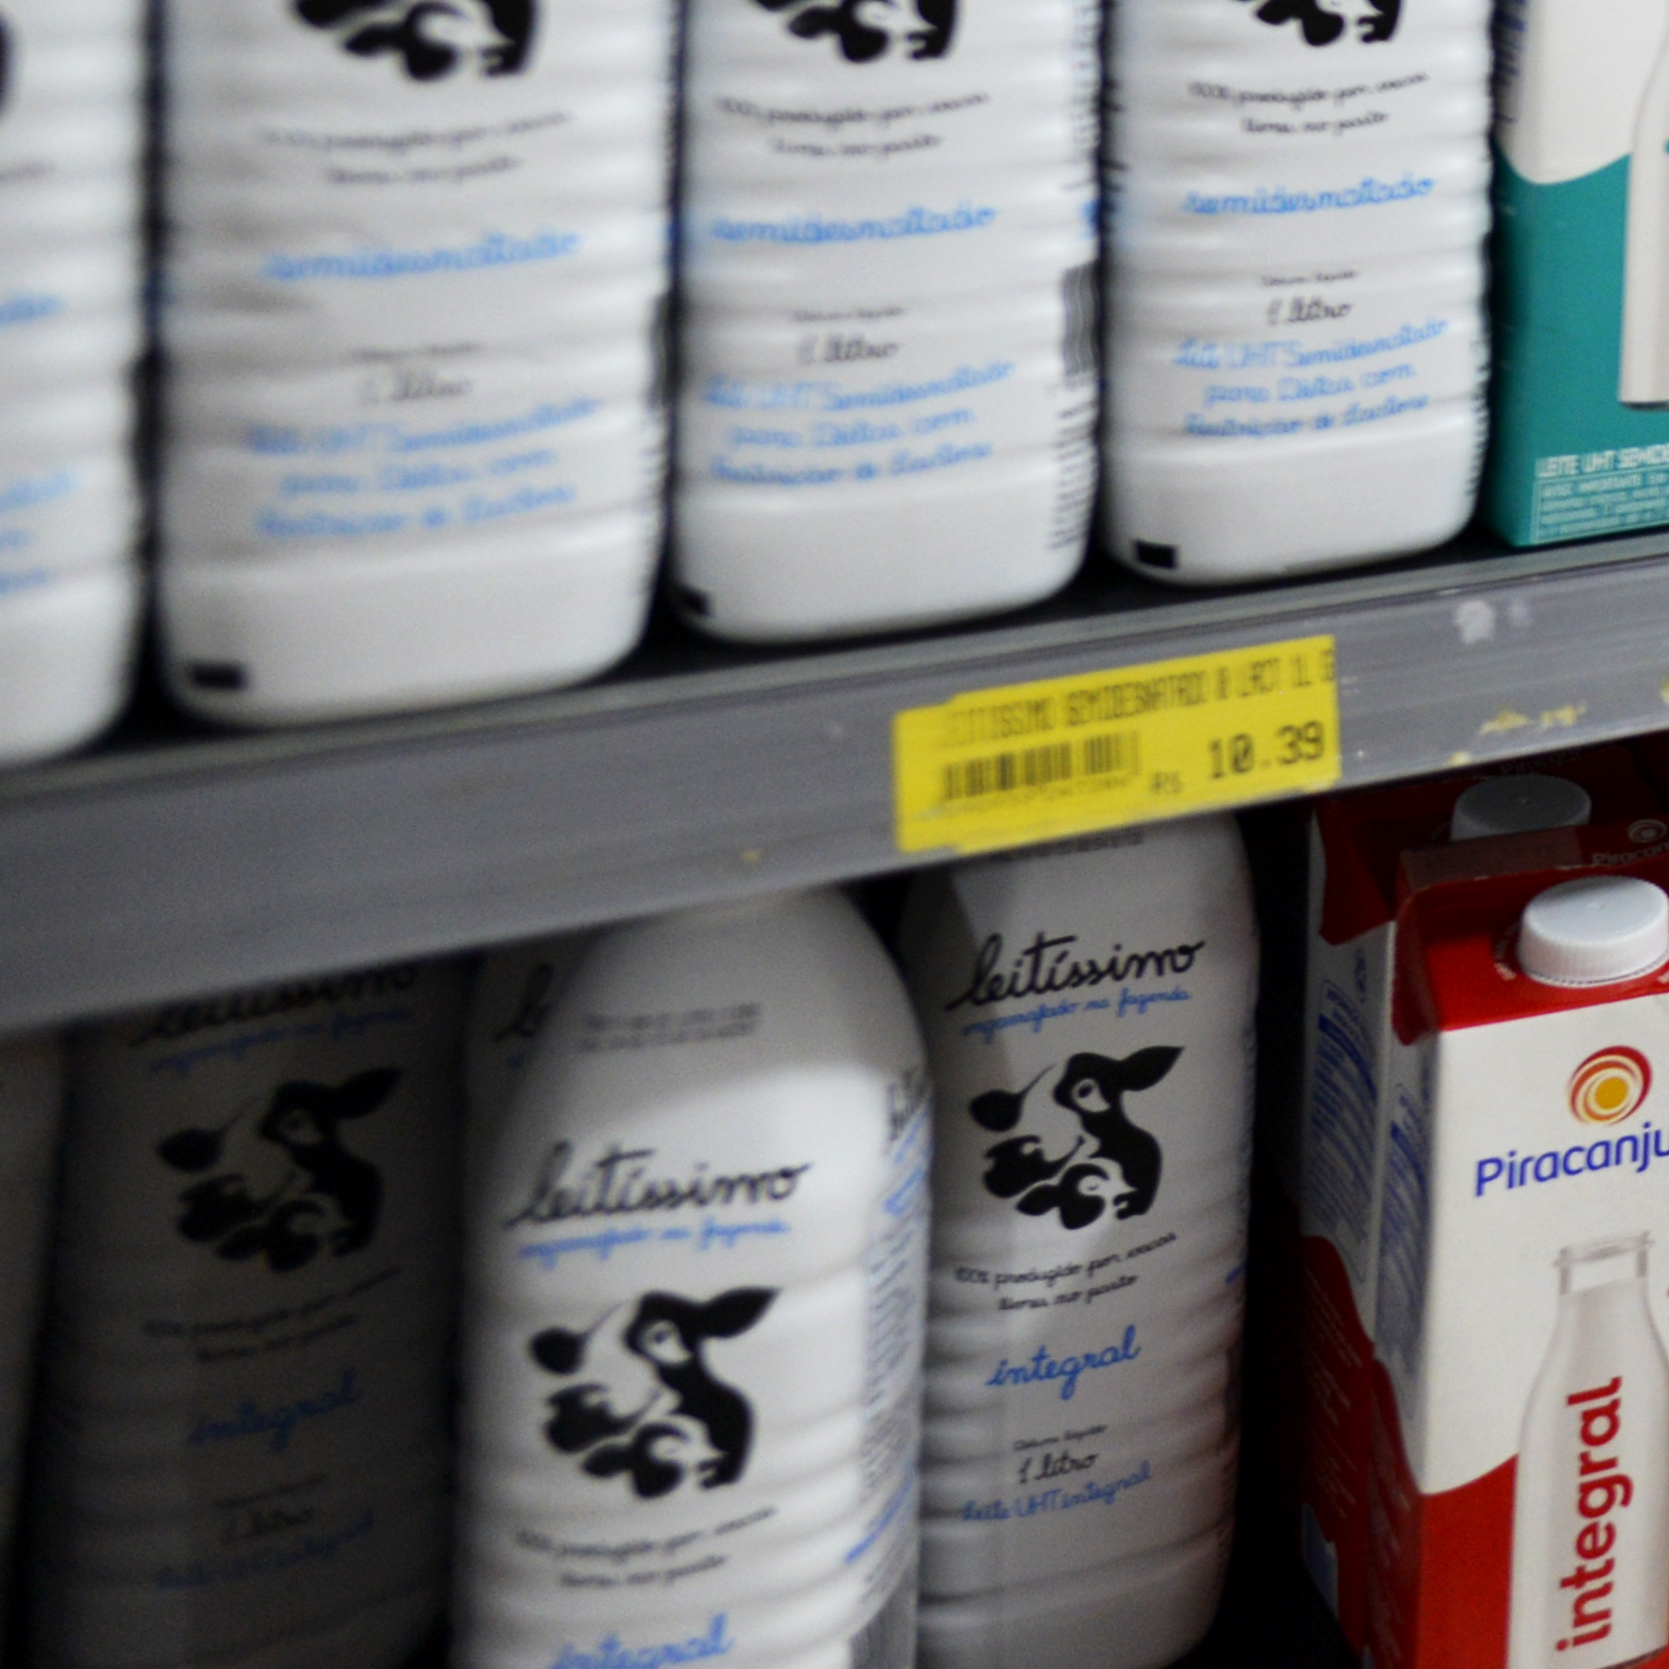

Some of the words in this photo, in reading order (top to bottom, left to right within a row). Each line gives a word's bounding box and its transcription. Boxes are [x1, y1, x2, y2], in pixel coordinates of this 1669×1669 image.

[1208, 719, 1326, 781] 10.39
[944, 931, 1206, 1012] leitíssimo
[985, 1324, 1141, 1401] integral
[1553, 1375, 1633, 1654] integral
